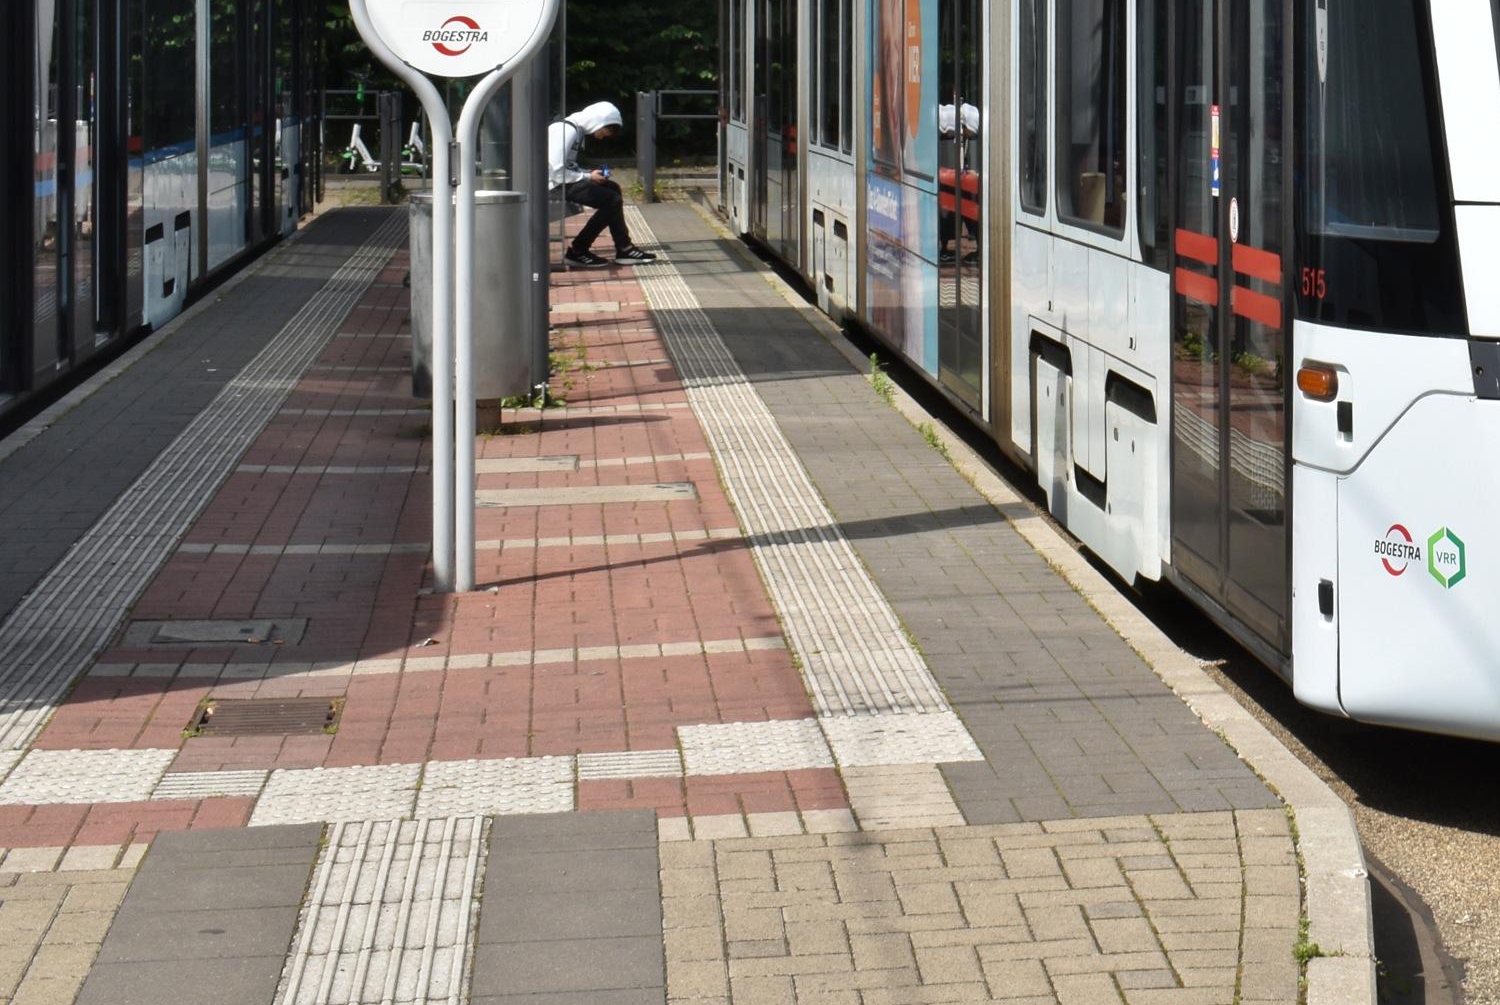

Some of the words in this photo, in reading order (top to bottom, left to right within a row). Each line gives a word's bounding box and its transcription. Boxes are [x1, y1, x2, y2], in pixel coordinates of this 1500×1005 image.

[422, 30, 488, 43] BOGESTRA
[1301, 266, 1326, 298] 515
[1374, 539, 1421, 561] BOGESTRA
[1436, 551, 1457, 565] VRR
